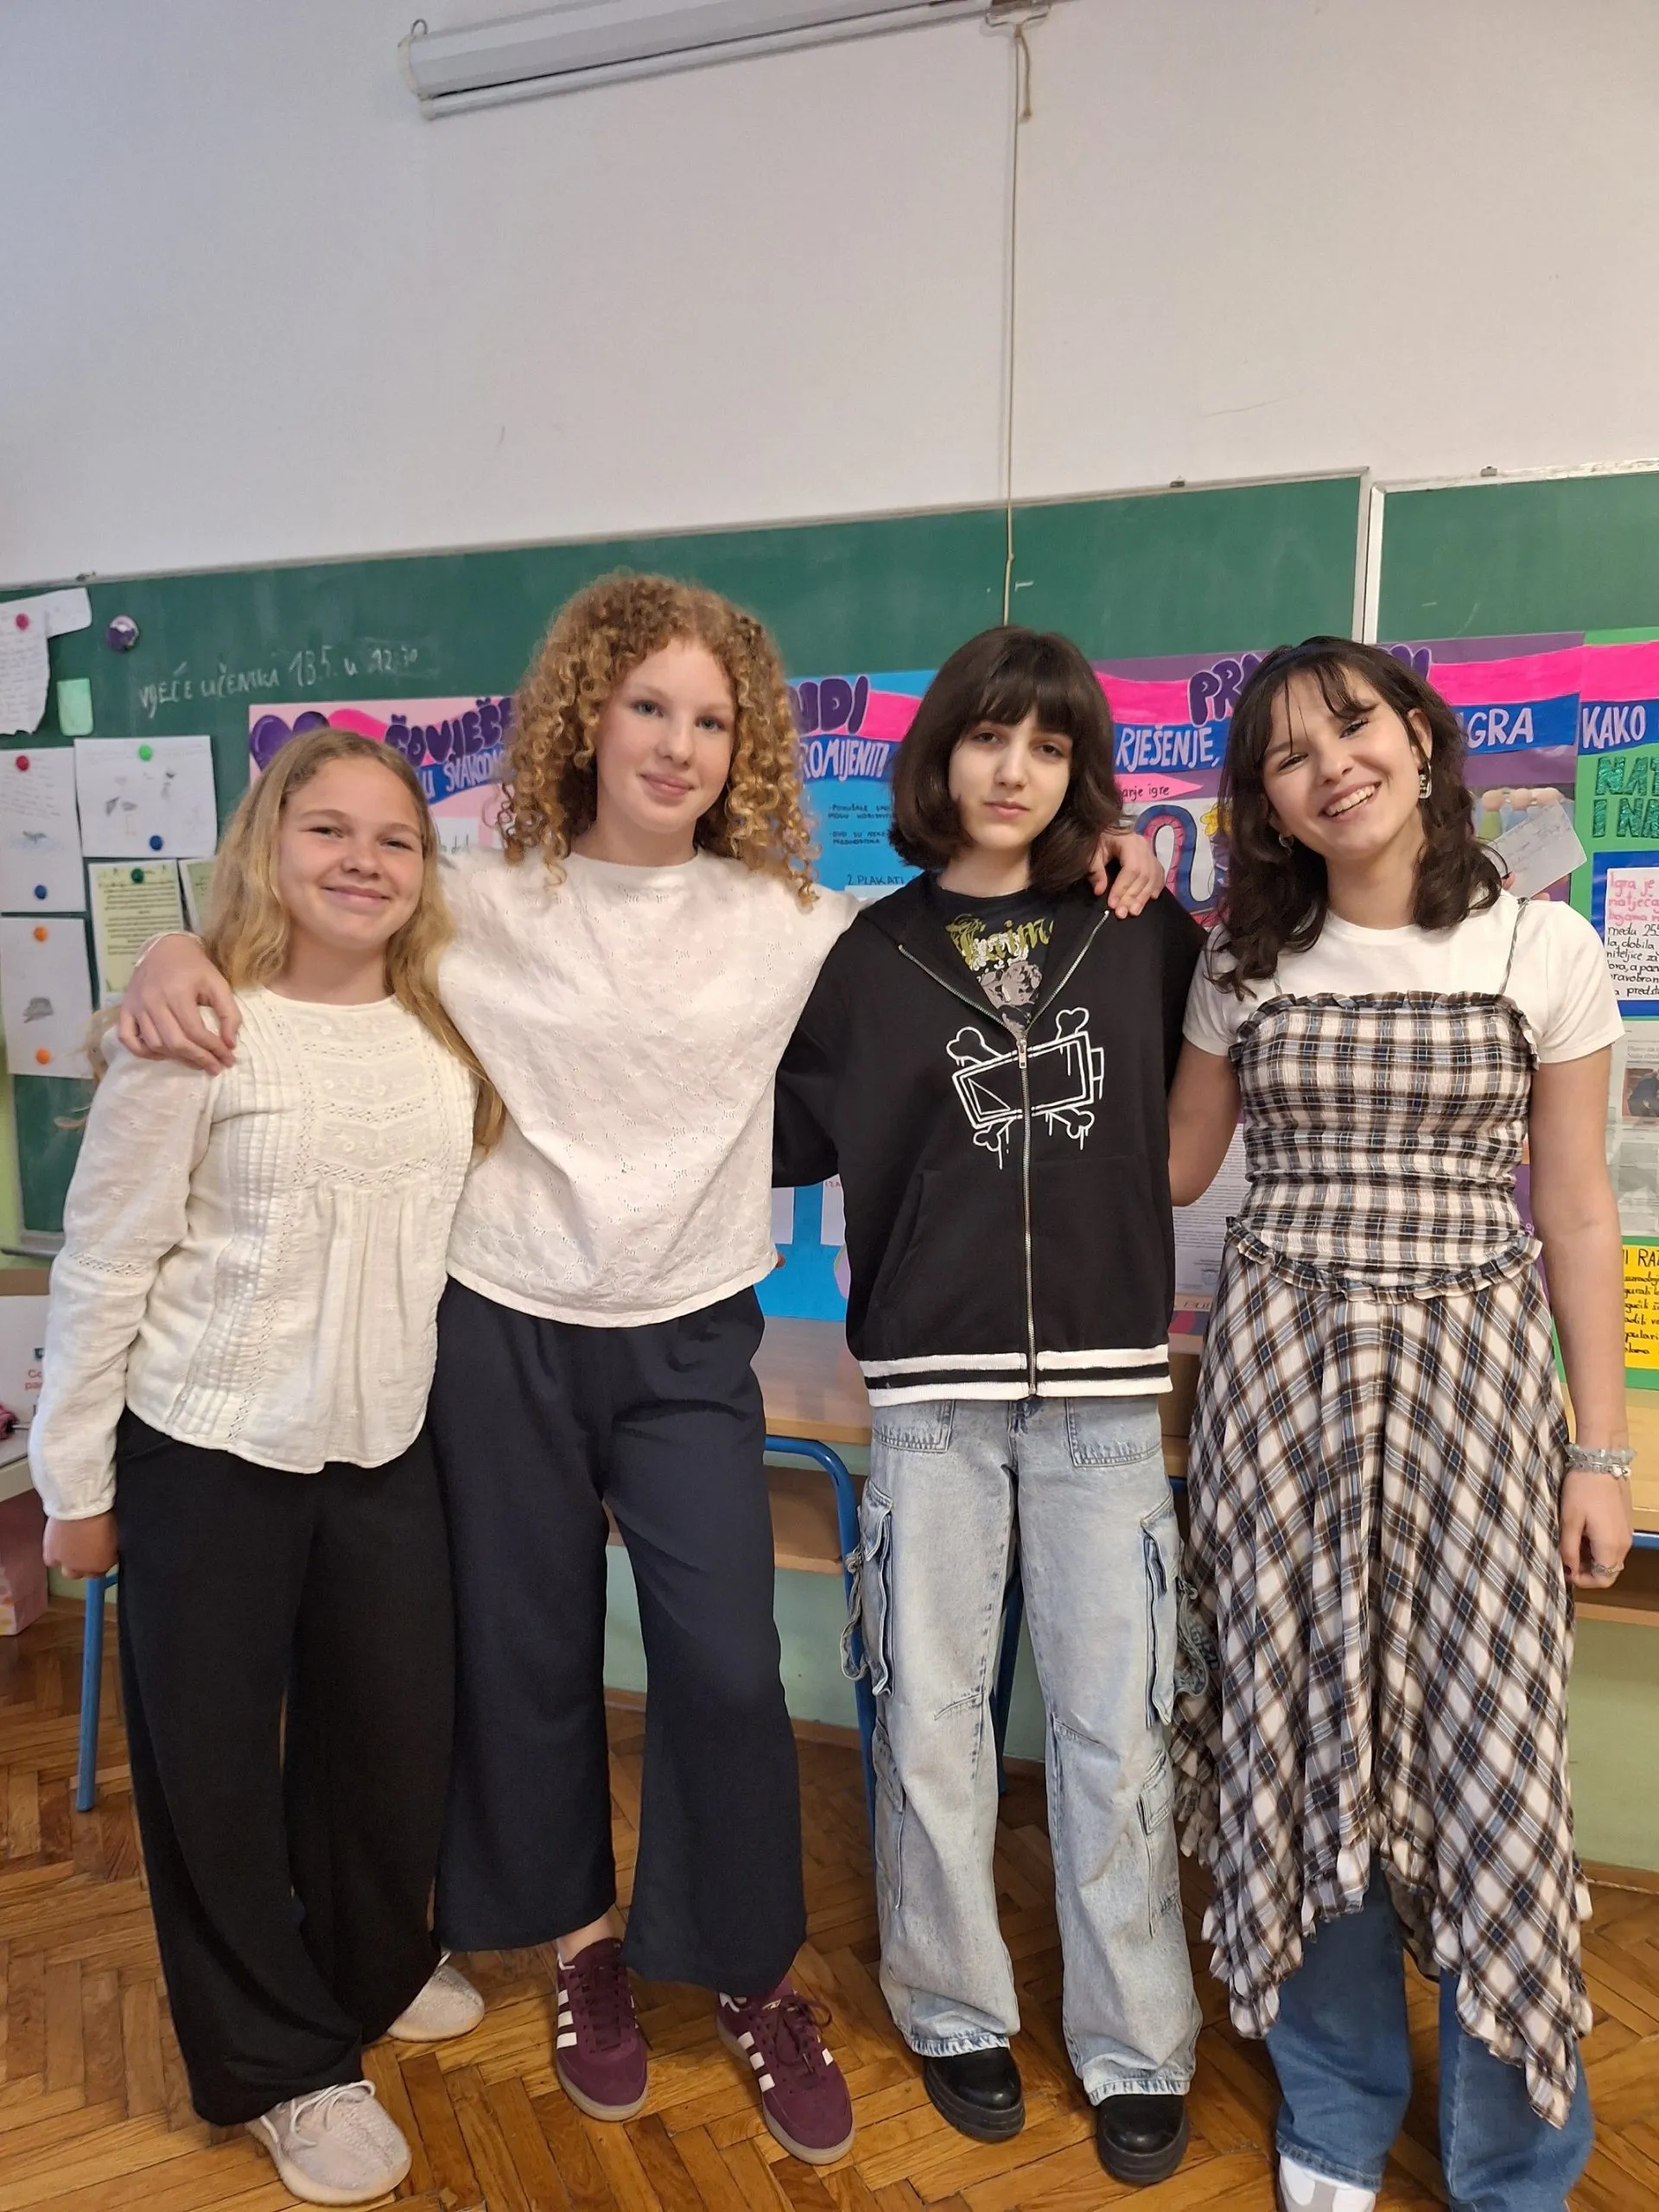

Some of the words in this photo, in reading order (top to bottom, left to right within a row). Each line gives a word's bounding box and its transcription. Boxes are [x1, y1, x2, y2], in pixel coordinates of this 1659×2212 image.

[1582, 706, 1646, 750] KAKO
[1147, 784, 1170, 798] igre
[857, 874, 905, 886] PLAKATI
[1610, 871, 1637, 897] Igra
[1641, 879, 1656, 897] je
[1622, 936, 1655, 950] dobila
